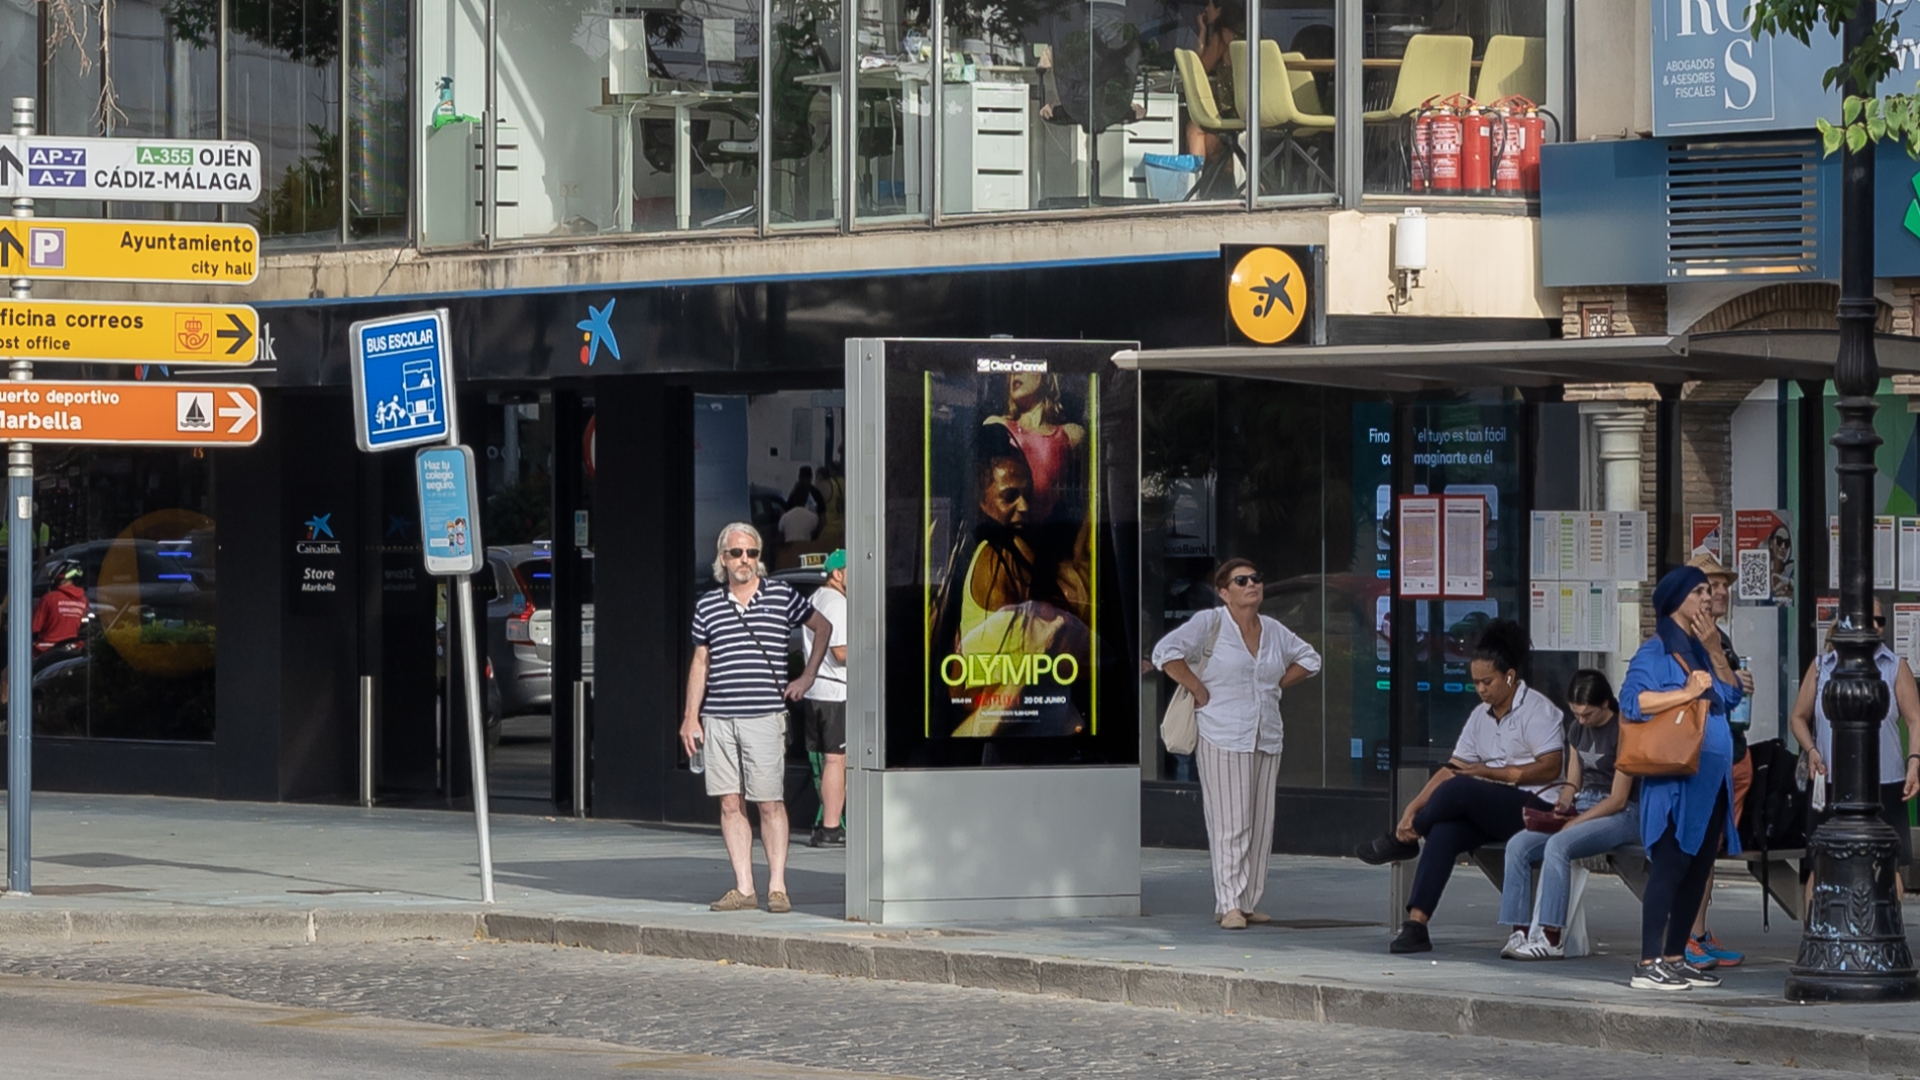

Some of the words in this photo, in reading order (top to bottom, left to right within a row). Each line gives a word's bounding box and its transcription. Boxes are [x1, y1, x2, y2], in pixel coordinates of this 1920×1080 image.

[1666, 58, 1715, 72] ABOGADOS
[1662, 75, 1669, 86] &
[1671, 72, 1715, 85] ASESORES
[1724, 38, 1757, 110] S
[1675, 86, 1716, 98] FISCALES
[31, 150, 84, 164] AP-7
[140, 149, 191, 163] A-355
[199, 145, 252, 167] OJÉN
[38, 171, 77, 185] A-7
[94, 166, 252, 190] CÁDIZ-MÁLAGA
[120, 231, 253, 253] Ayuntamiento
[192, 262, 219, 274] city
[225, 262, 253, 275] hall
[0, 308, 56, 327] ficina
[65, 313, 144, 329] correos
[0, 336, 19, 349] ost
[26, 335, 71, 351] office
[366, 336, 387, 353] BUS
[388, 329, 434, 350] ESCOLAR
[990, 361, 1013, 372] Clear
[1013, 361, 1047, 372] Channel
[0, 389, 40, 404] uerto
[46, 389, 120, 406] deportivo
[0, 410, 83, 430] arbella
[1417, 427, 1427, 442] el
[1429, 431, 1451, 446] tuyo
[1452, 433, 1464, 443] es
[1465, 429, 1483, 442] tan
[1485, 427, 1507, 442] fácil
[424, 460, 441, 470] Haz
[1413, 449, 1468, 468] maginarte
[1469, 453, 1482, 465] en
[1484, 450, 1493, 464] él
[425, 470, 454, 481] colegio
[426, 481, 456, 492] seguro.
[296, 543, 341, 554] CaixaBank
[303, 567, 335, 580] Store
[301, 583, 336, 591] Marbella
[940, 652, 1079, 686] OLYMPO
[1023, 696, 1034, 704] 20
[1034, 696, 1044, 704] DE
[1044, 696, 1067, 704] JUNIO
